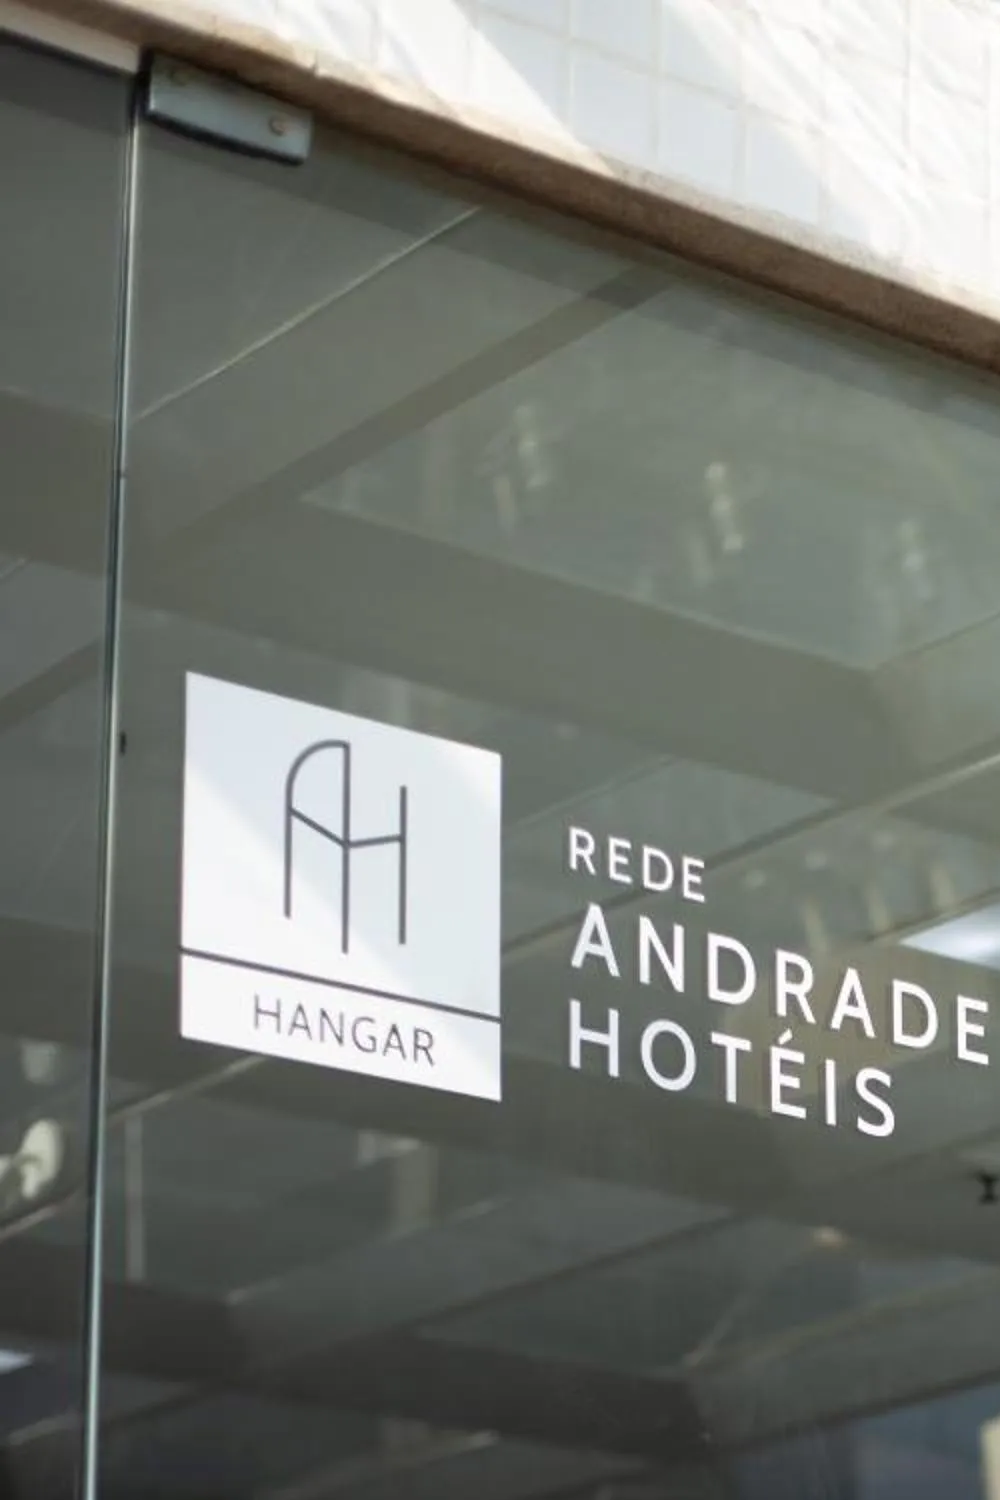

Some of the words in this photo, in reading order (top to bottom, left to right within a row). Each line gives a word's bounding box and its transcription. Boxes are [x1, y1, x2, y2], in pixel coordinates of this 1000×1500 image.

[568, 827, 706, 902] REDE
[252, 995, 436, 1067] HANGAR
[571, 905, 990, 1065] ANDRADE
[569, 1000, 896, 1138] HOTÉIS
